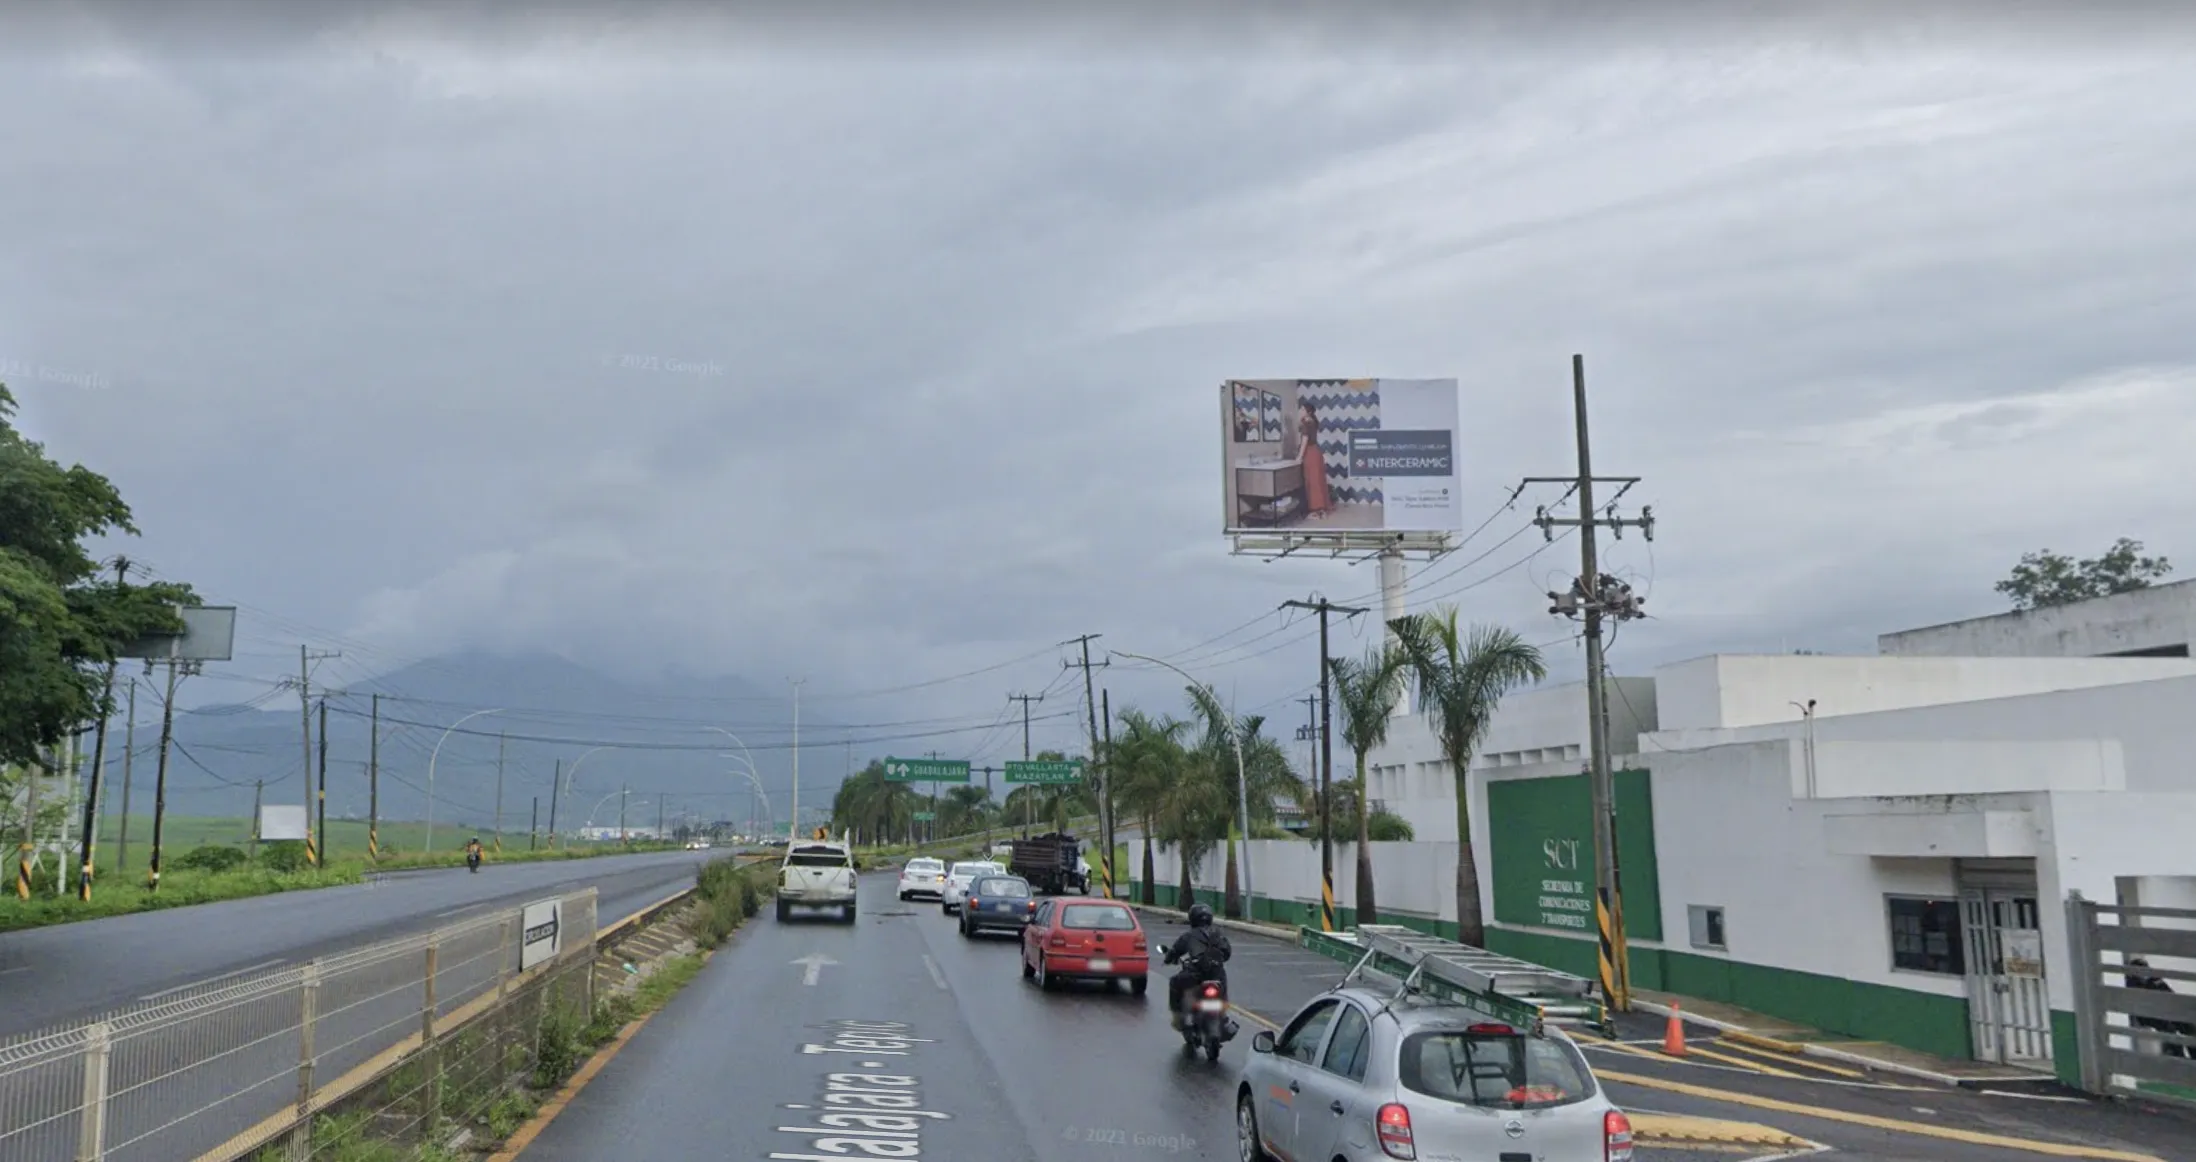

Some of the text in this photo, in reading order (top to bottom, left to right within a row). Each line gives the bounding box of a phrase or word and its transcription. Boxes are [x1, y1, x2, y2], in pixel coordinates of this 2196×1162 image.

[1367, 457, 1448, 468] INTERCERAMIC
[914, 764, 968, 776] GUADALAJARA
[1025, 763, 1070, 771] VALLARTA
[1014, 773, 1065, 781] MAZATLAN
[1543, 838, 1579, 869] SCT
[803, 1020, 938, 1056] Tepic
